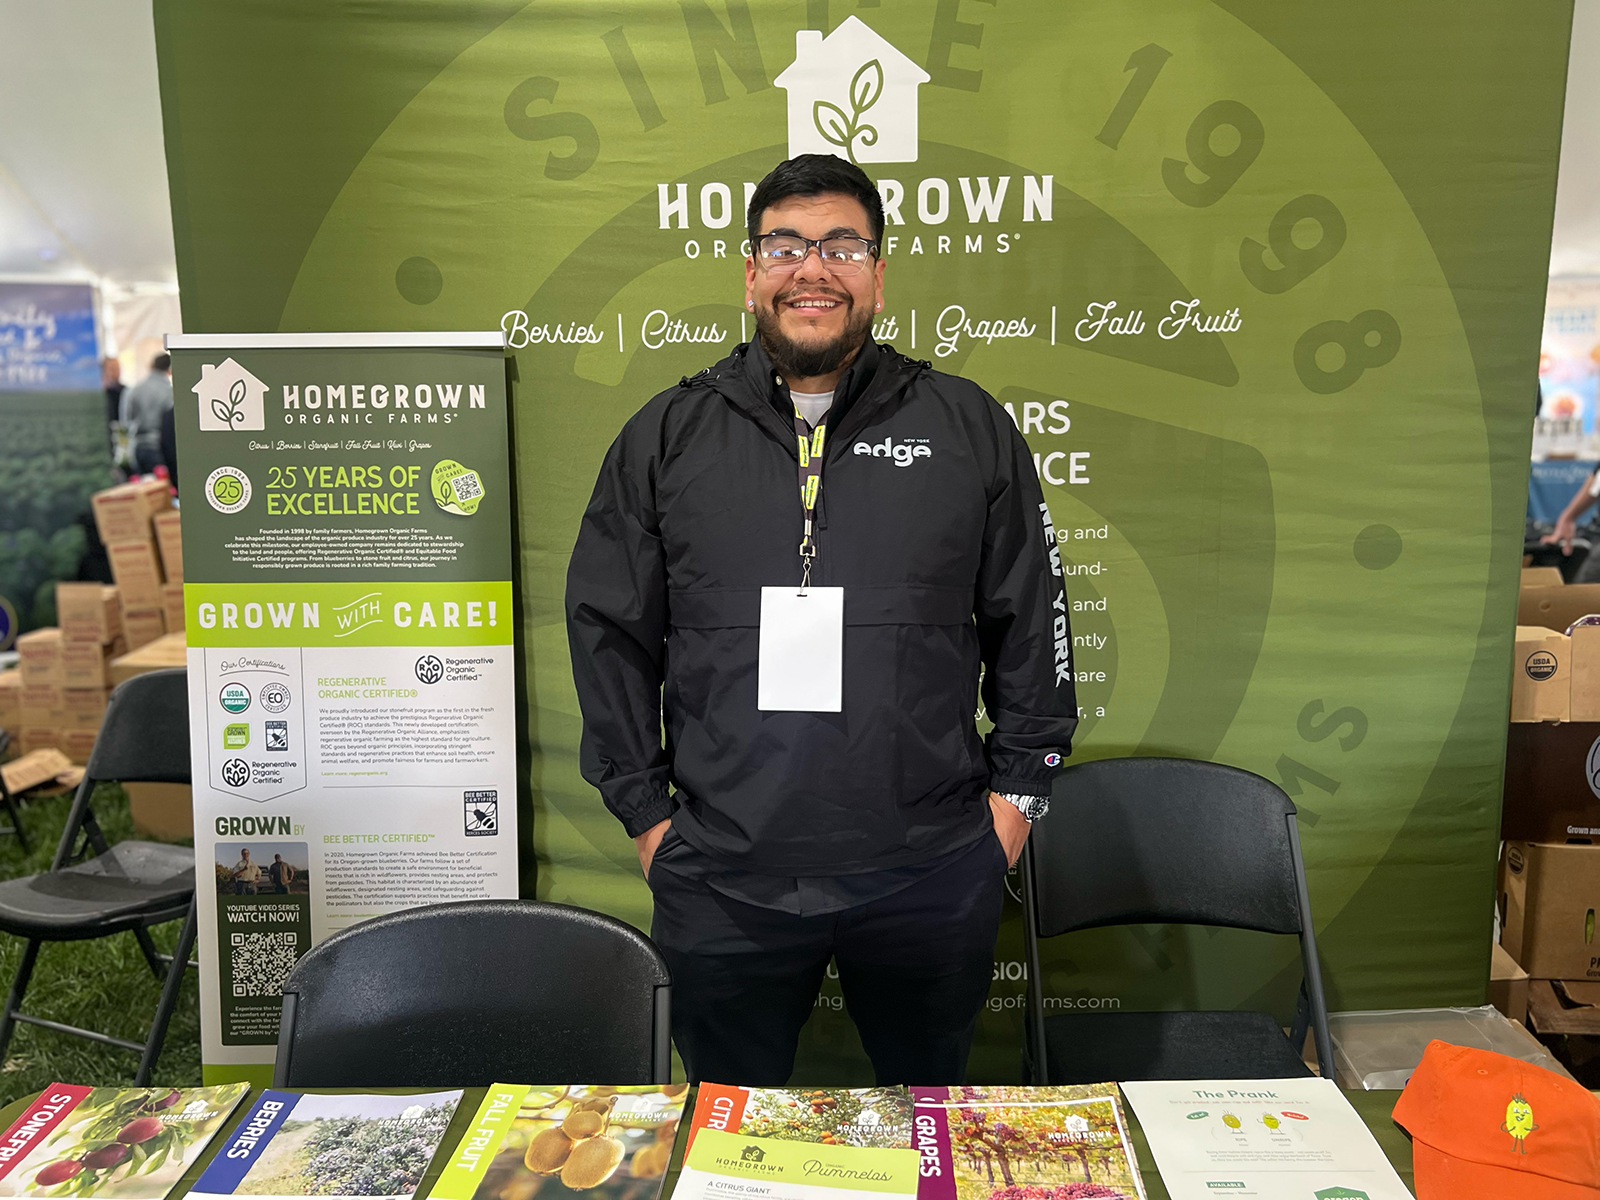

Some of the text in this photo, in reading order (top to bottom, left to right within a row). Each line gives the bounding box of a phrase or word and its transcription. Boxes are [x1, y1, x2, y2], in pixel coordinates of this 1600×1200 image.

[500, 309, 604, 349] Berries
[641, 309, 727, 349] Citrus
[934, 304, 1036, 357] Grapes
[1074, 301, 1146, 342] Fall
[1157, 298, 1242, 341] Fruit
[283, 384, 486, 409] HOMEGROWN
[285, 414, 372, 424] ORGANIC
[249, 440, 270, 450] Citrus
[276, 440, 302, 450] Berries
[308, 440, 339, 450] Stonefruit
[346, 440, 361, 450] Fall
[362, 440, 381, 450] Fruit
[408, 440, 432, 452] Grapes
[854, 436, 932, 467] edge
[266, 467, 297, 488] 25
[303, 466, 383, 488] YEARS
[390, 466, 420, 488] OF
[216, 481, 240, 498] 25
[268, 492, 420, 515] EXCELLENCE
[1074, 525, 1108, 540] and
[1038, 502, 1062, 577] NEW
[1052, 589, 1071, 688] YORK
[1073, 597, 1107, 611] and
[198, 601, 498, 630] GROWN WITH CARE!
[220, 656, 286, 671] Our Certifications
[446, 658, 494, 666] Regenerative
[446, 666, 475, 674] Organic
[318, 677, 387, 686] REGENERATIVE
[318, 689, 418, 699] ORGANIC CERTIFIED®
[252, 761, 297, 769] Regenerative
[215, 816, 305, 836] GROWN BY
[1567, 825, 1589, 834] Grown
[323, 835, 340, 843] BEE
[342, 834, 380, 843] BETTER
[227, 912, 300, 923] WATCH NOW!
[1192, 1090, 1279, 1098] The Prank
[158, 1111, 218, 1120] HOMEGROWN
[226, 1100, 284, 1159] BERRIES
[456, 1093, 514, 1172] FALL FRUIT
[1048, 1131, 1112, 1139] HOMEGROWN
[915, 1115, 941, 1177] GRAPES
[716, 1157, 784, 1172] HOMEGROWN
[803, 1159, 893, 1182] Pummelas
[715, 1182, 744, 1192] CITRUS
[746, 1186, 771, 1195] GIANT
